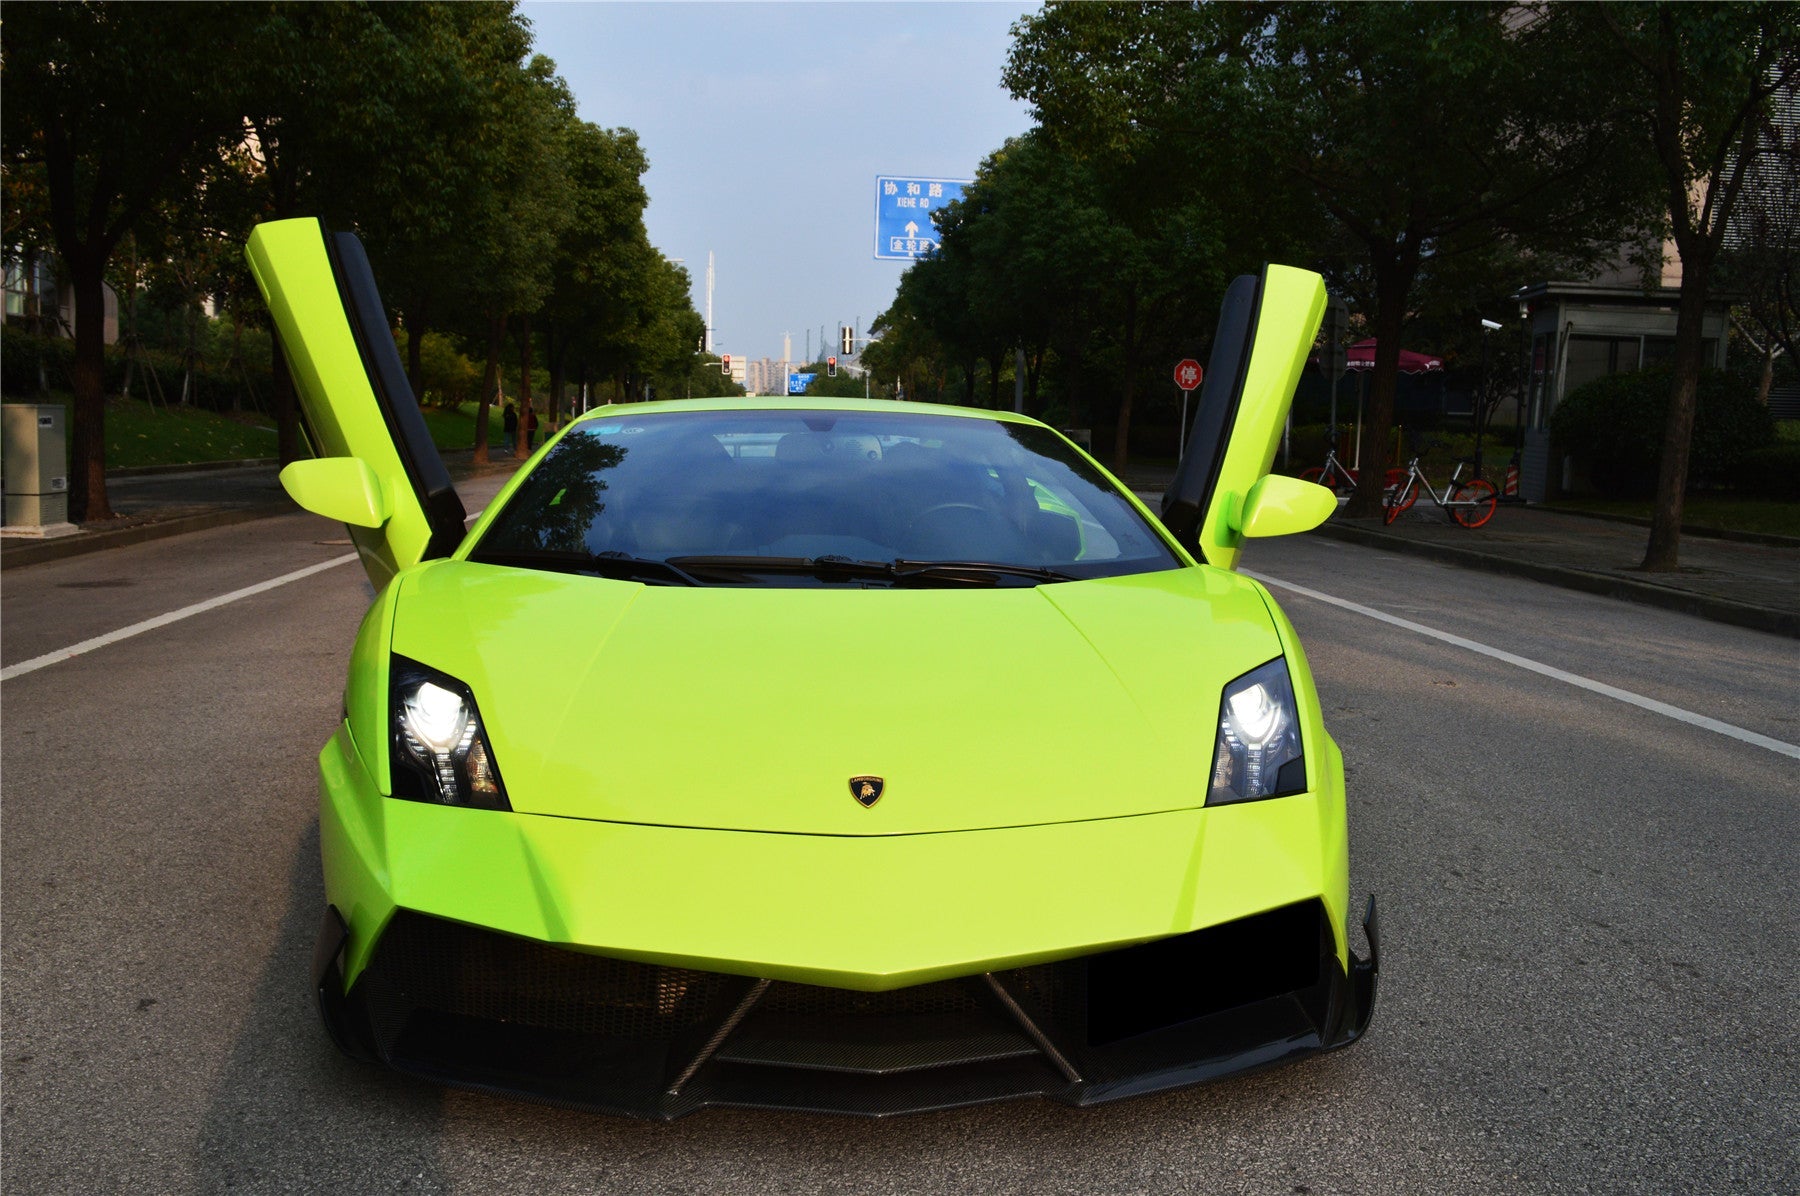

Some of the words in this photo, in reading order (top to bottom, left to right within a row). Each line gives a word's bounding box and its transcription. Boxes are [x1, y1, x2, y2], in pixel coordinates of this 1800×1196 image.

[884, 181, 943, 198] 协和路
[897, 197, 917, 208] XIEHE
[919, 197, 930, 208] RD
[1181, 365, 1197, 384] 停
